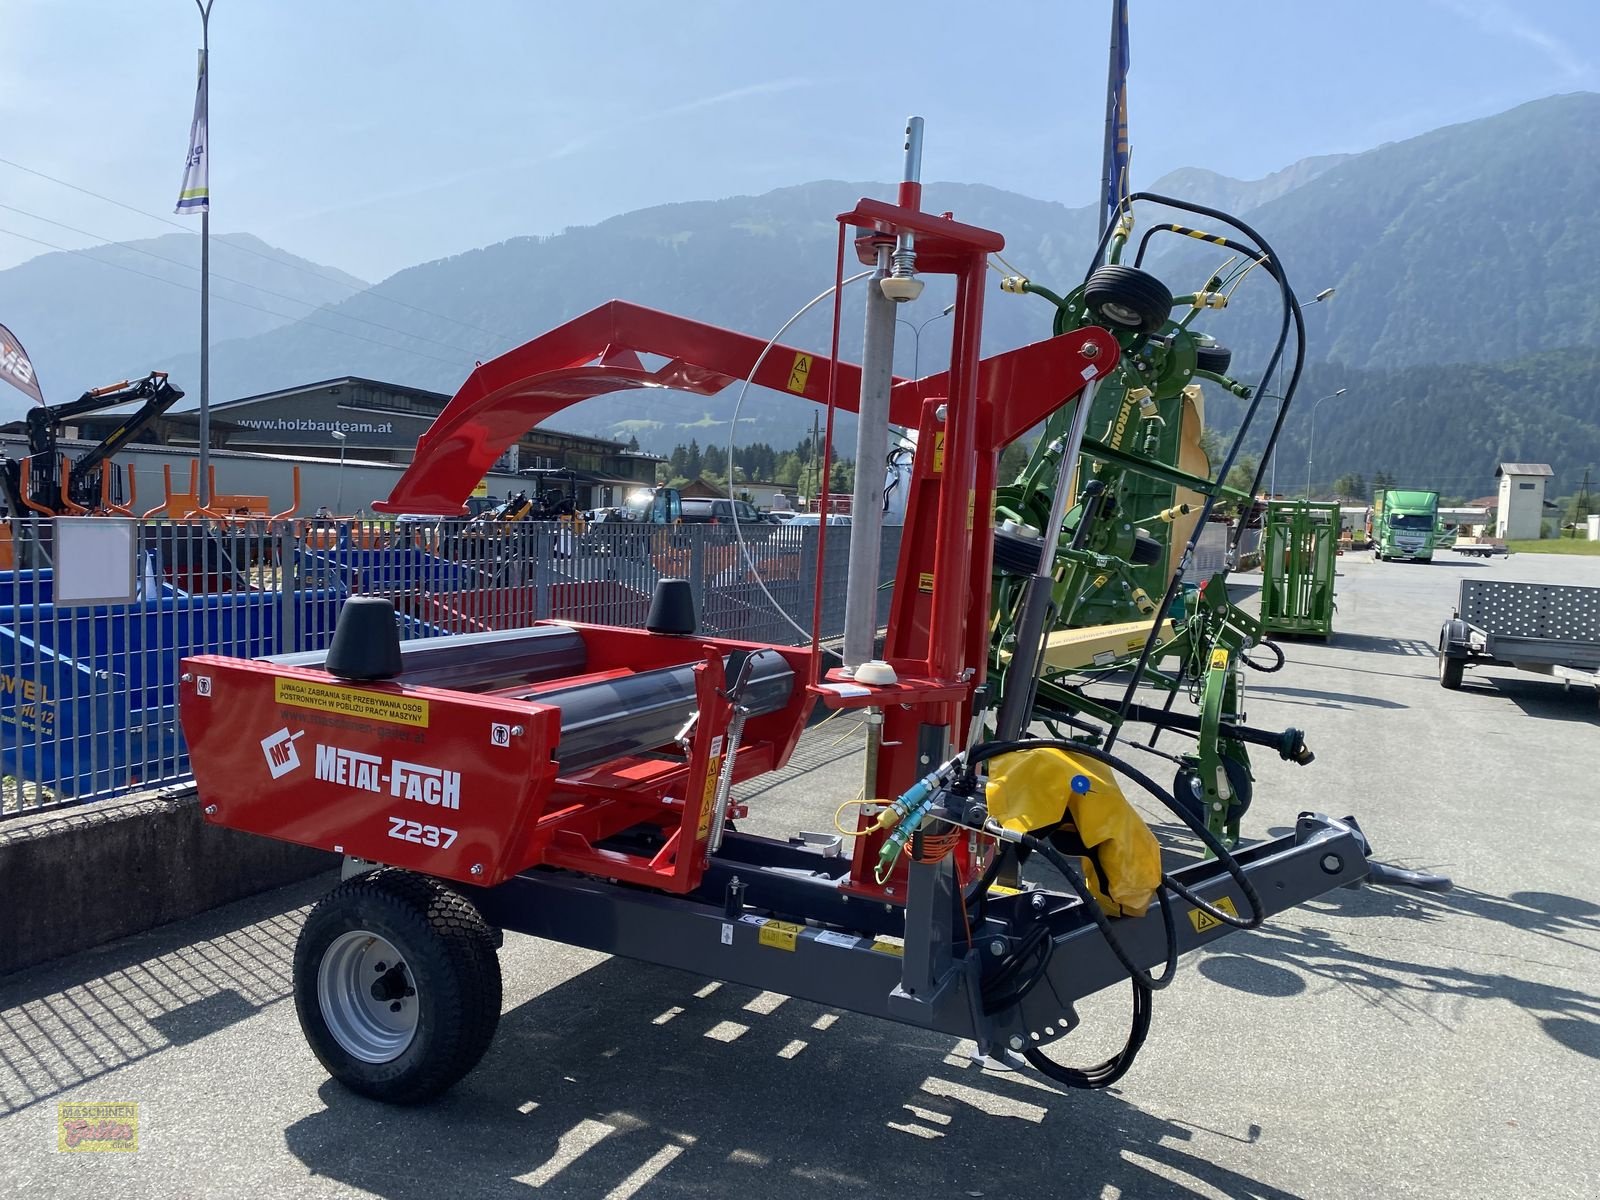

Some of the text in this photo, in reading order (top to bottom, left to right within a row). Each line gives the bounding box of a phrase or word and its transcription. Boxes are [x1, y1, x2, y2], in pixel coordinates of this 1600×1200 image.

[237, 418, 393, 433] www.holzbauteam.at
[1110, 402, 1132, 451] KRON
[280, 692, 327, 706] POSTRONNYCH
[328, 700, 335, 708] W
[365, 706, 389, 717] PRACY
[389, 710, 423, 722] MASZYNY
[281, 683, 307, 694] UWAGA!
[307, 687, 340, 700] ZABRANIA
[353, 695, 401, 710] PRZEBYWANIA
[402, 703, 423, 713] OSÓB
[388, 816, 459, 850] Z237
